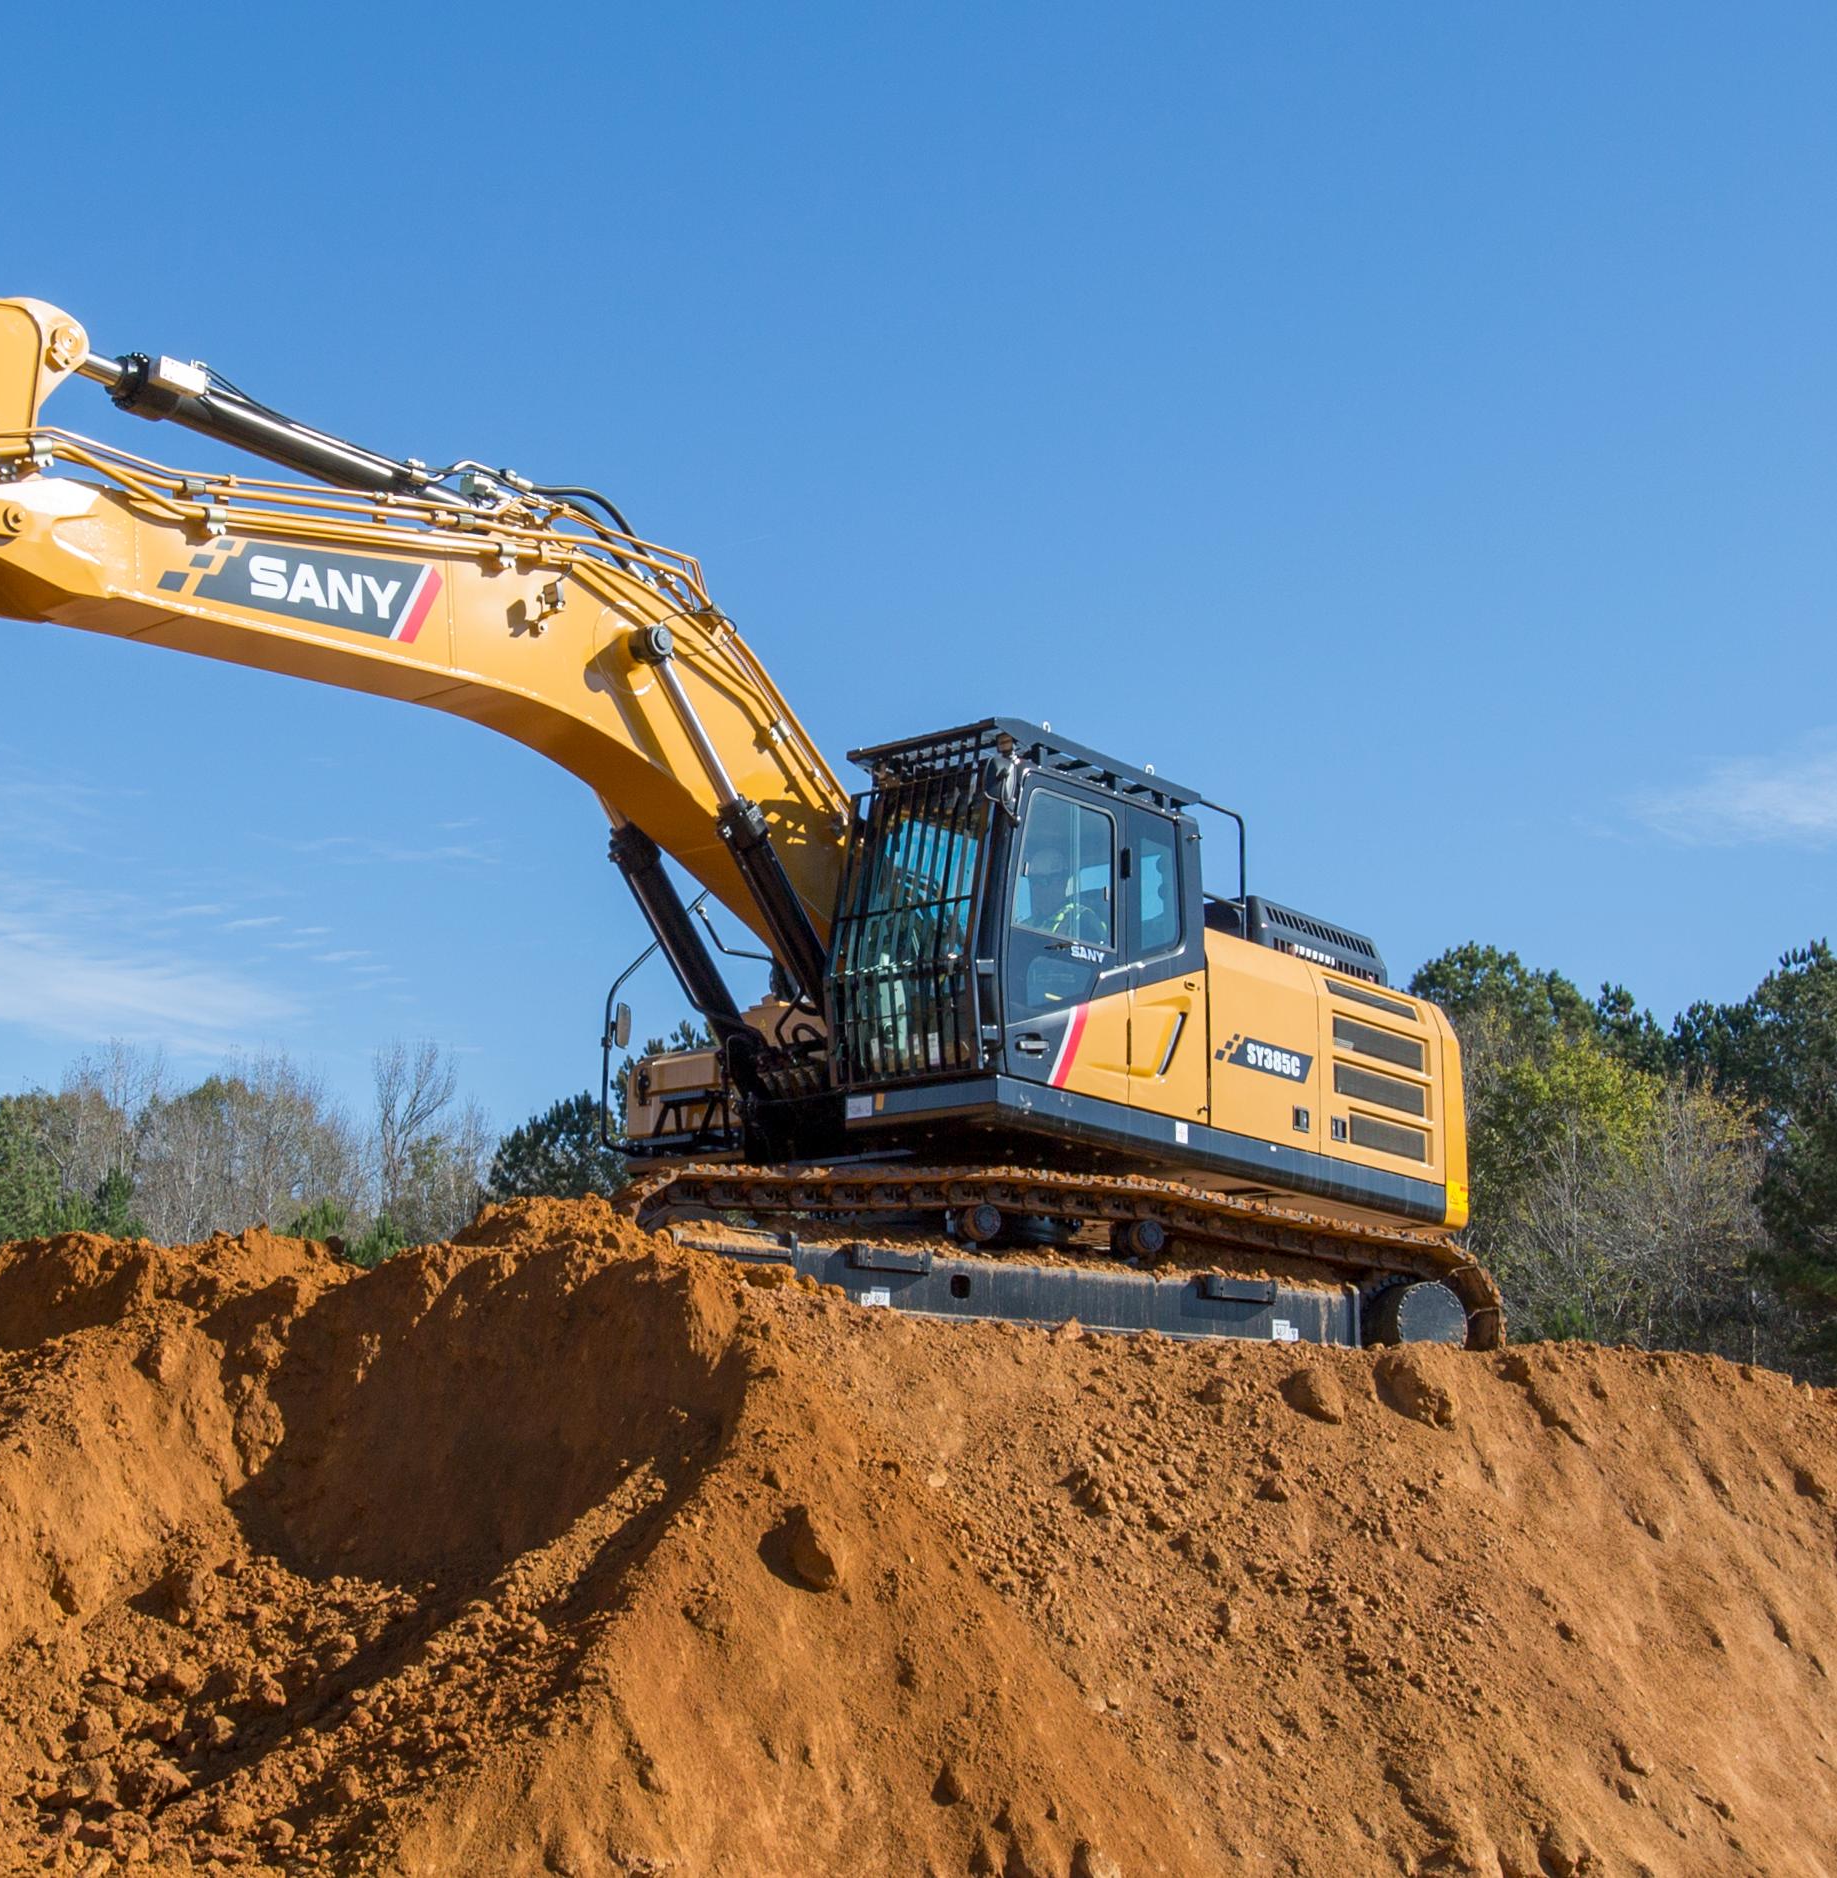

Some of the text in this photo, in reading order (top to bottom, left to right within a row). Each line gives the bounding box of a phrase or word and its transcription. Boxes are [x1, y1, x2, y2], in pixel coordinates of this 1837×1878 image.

[249, 555, 402, 619] SANY
[1070, 945, 1105, 964] SANY
[1246, 1043, 1301, 1077] SY385C
